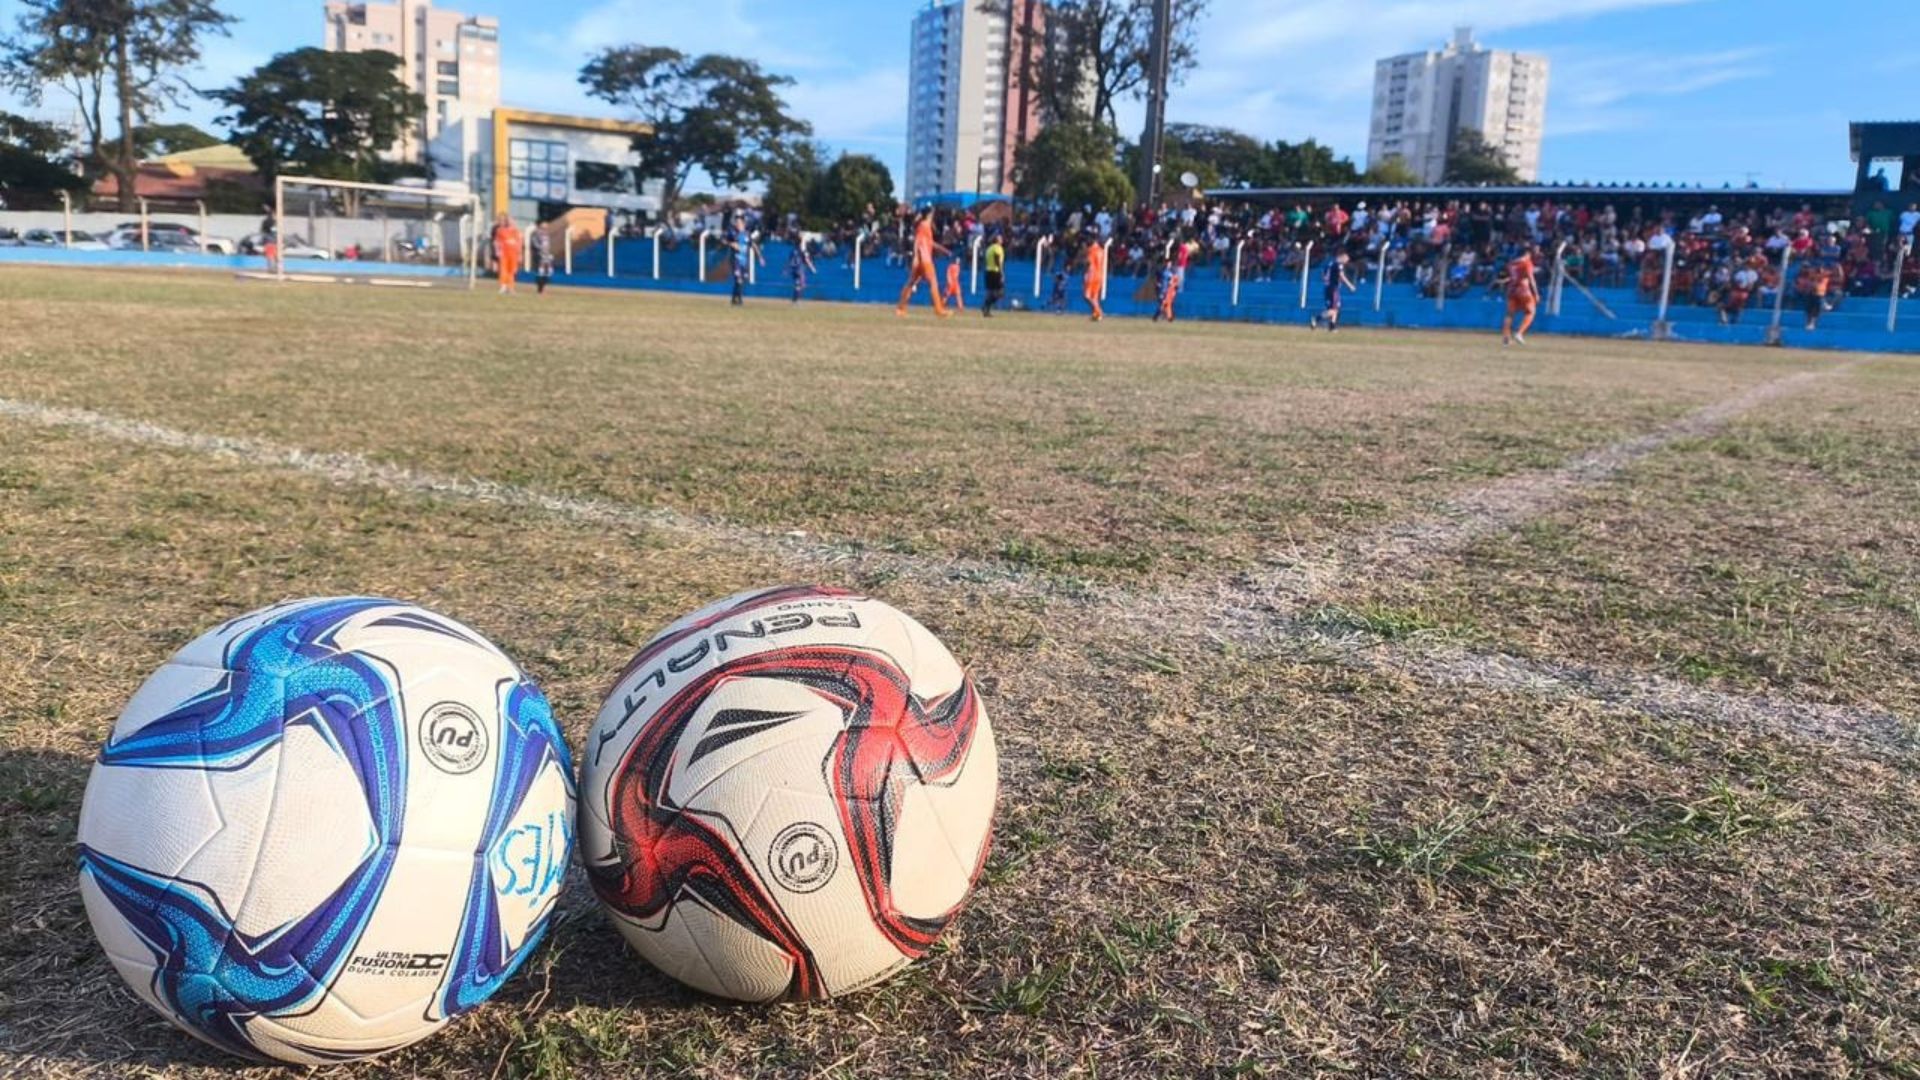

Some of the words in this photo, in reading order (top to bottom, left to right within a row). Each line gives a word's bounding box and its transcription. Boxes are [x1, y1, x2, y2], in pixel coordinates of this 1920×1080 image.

[594, 611, 861, 767] PENALTY
[436, 726, 474, 748] PU
[789, 842, 820, 875] PU
[352, 956, 408, 970] FUSION
[376, 951, 410, 960] ULTRA
[347, 965, 385, 976] DUPLA
[389, 969, 440, 978] COLAGEM
